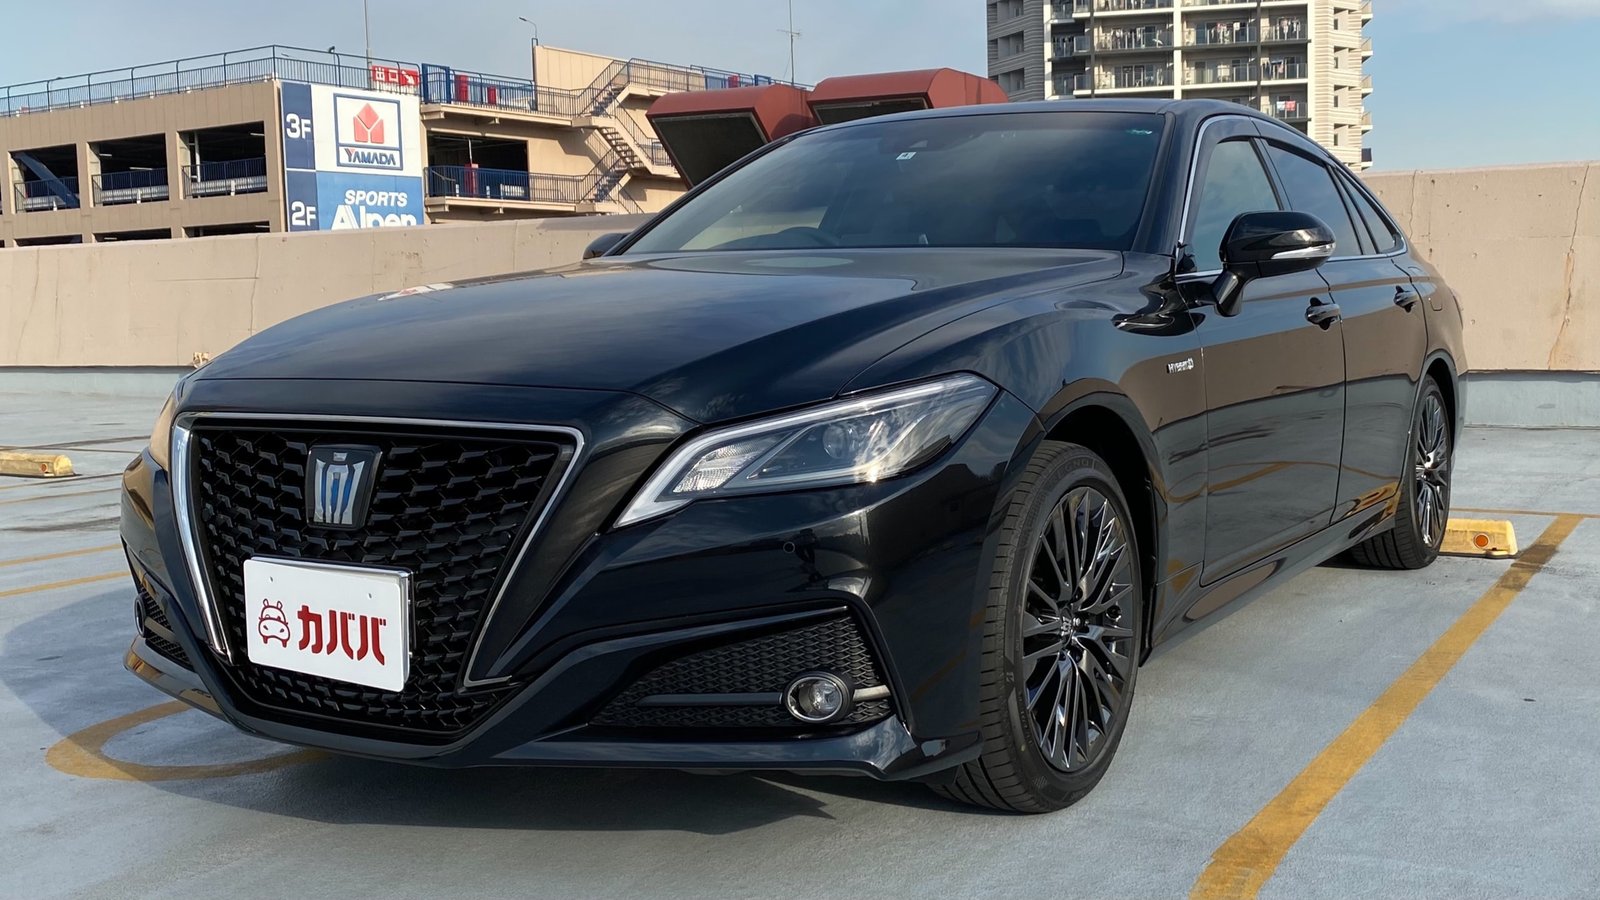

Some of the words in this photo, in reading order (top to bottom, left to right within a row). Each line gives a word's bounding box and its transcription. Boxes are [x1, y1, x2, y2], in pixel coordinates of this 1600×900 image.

[376, 67, 399, 82] 出口
[286, 113, 311, 139] 3F
[344, 148, 396, 165] YAMADA
[344, 189, 408, 207] SPORTS
[291, 201, 317, 226] 2F
[297, 604, 387, 666] カババ
